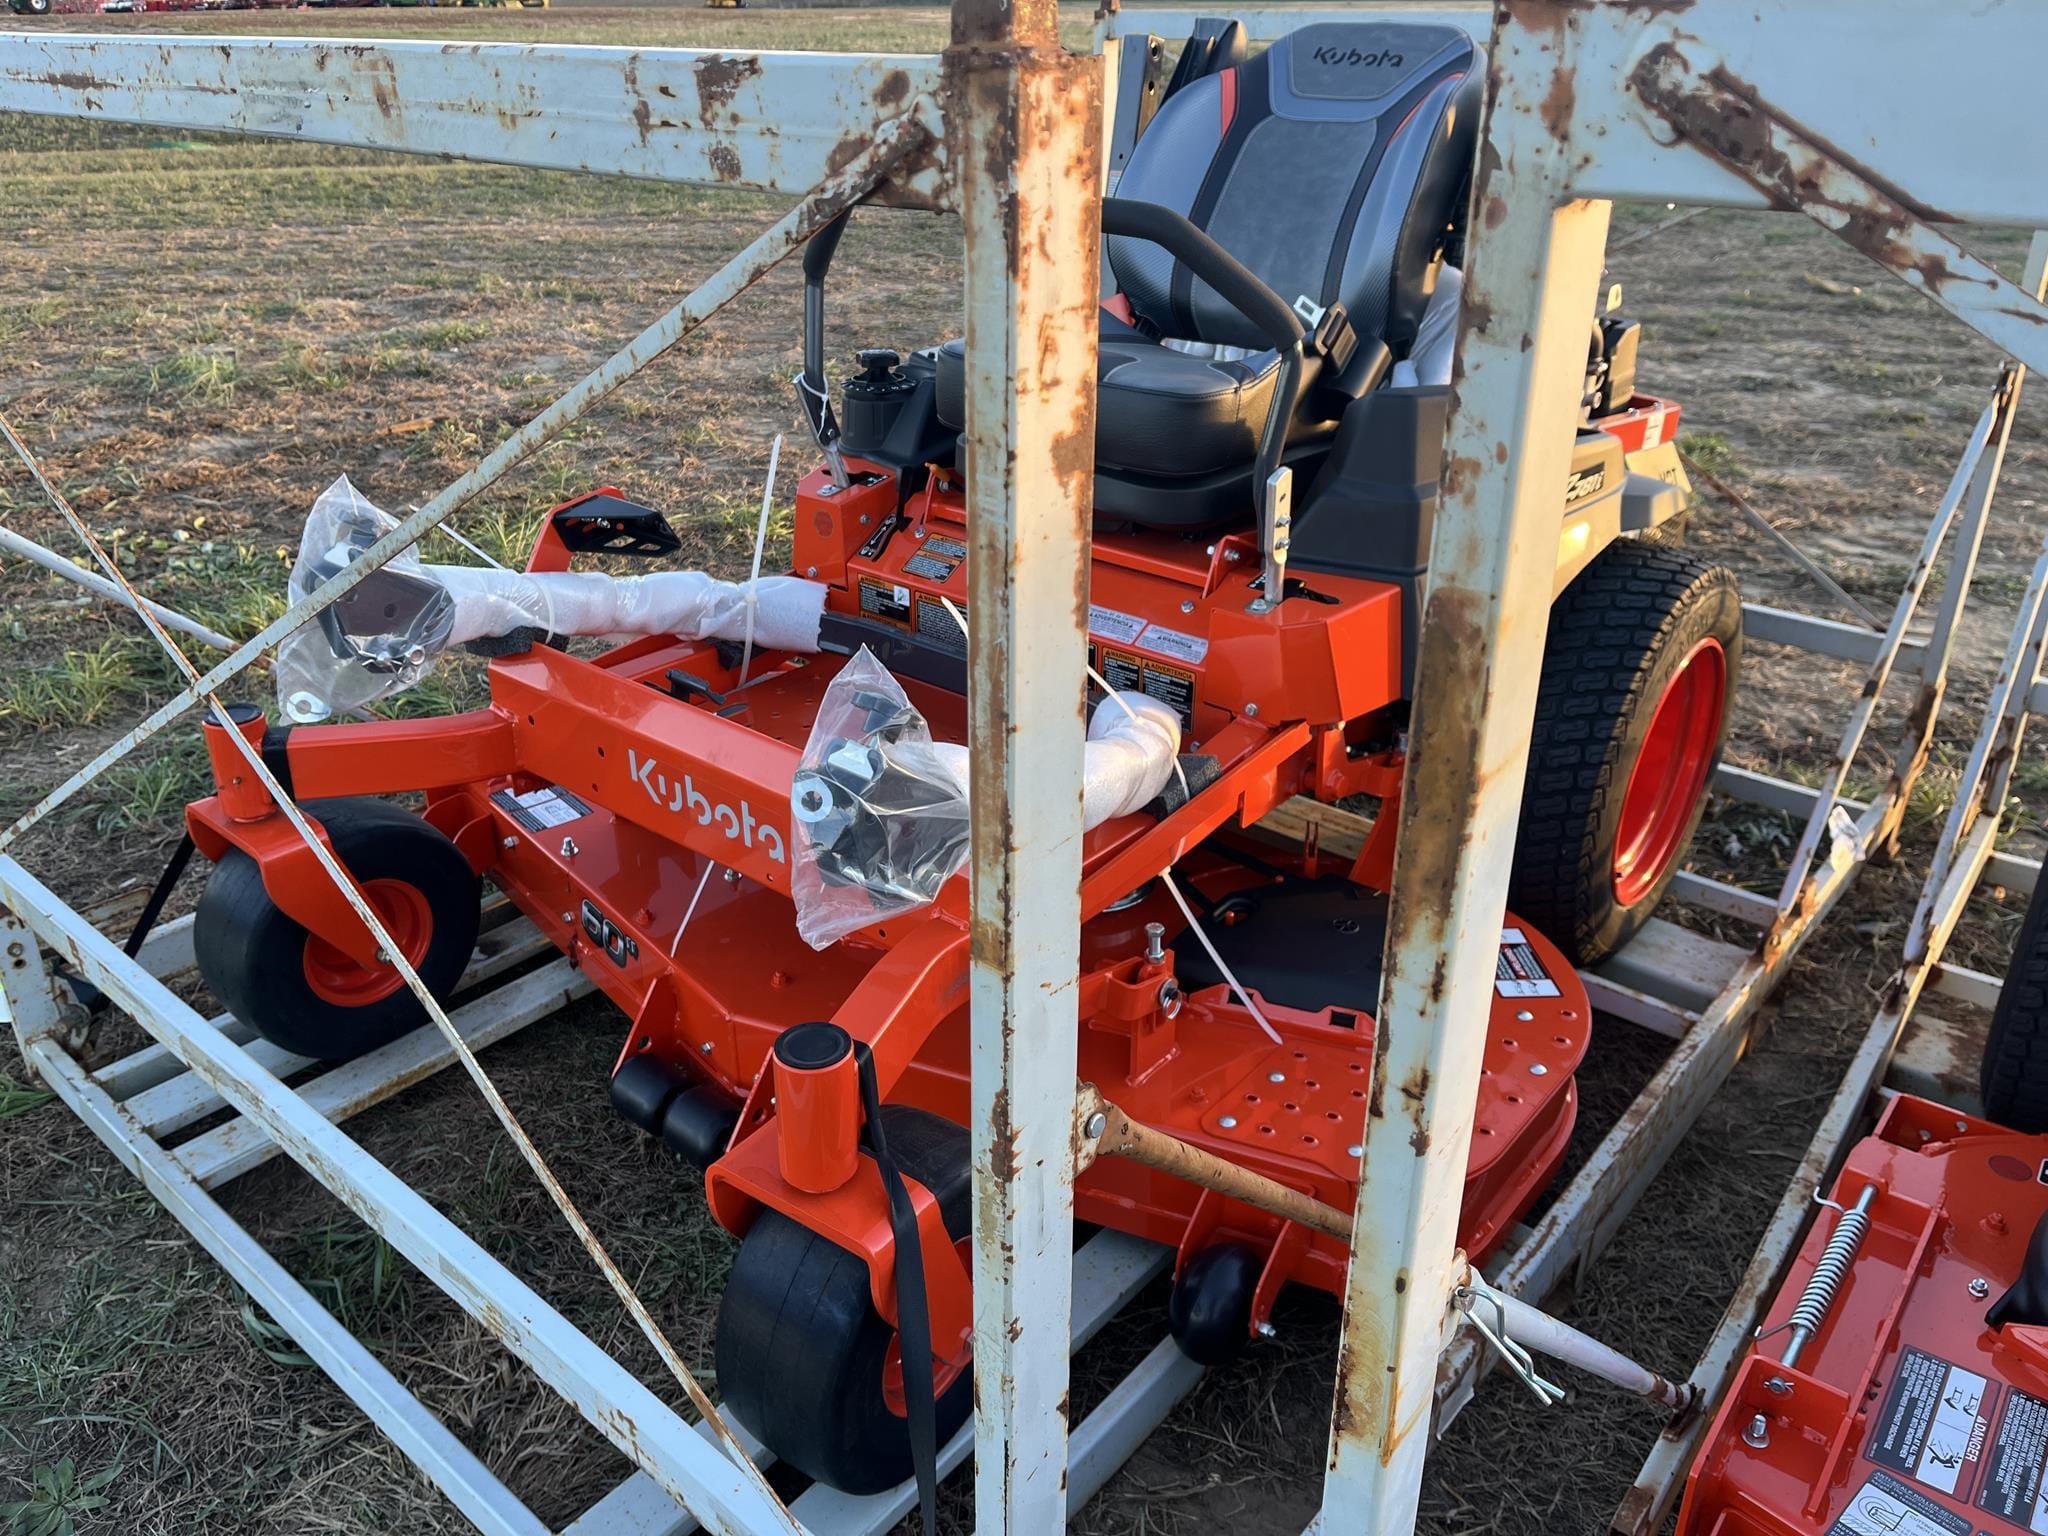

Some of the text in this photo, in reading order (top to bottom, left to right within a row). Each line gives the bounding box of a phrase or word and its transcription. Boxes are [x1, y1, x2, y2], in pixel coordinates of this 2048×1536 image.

[1313, 46, 1403, 67] Kubota
[1151, 663, 1193, 680] ADVERTENCIA
[627, 748, 785, 864] Kubota
[1913, 1406, 1922, 1418] FEET
[1909, 1444, 1918, 1455] ALL
[1965, 1424, 1987, 1462] DANGER
